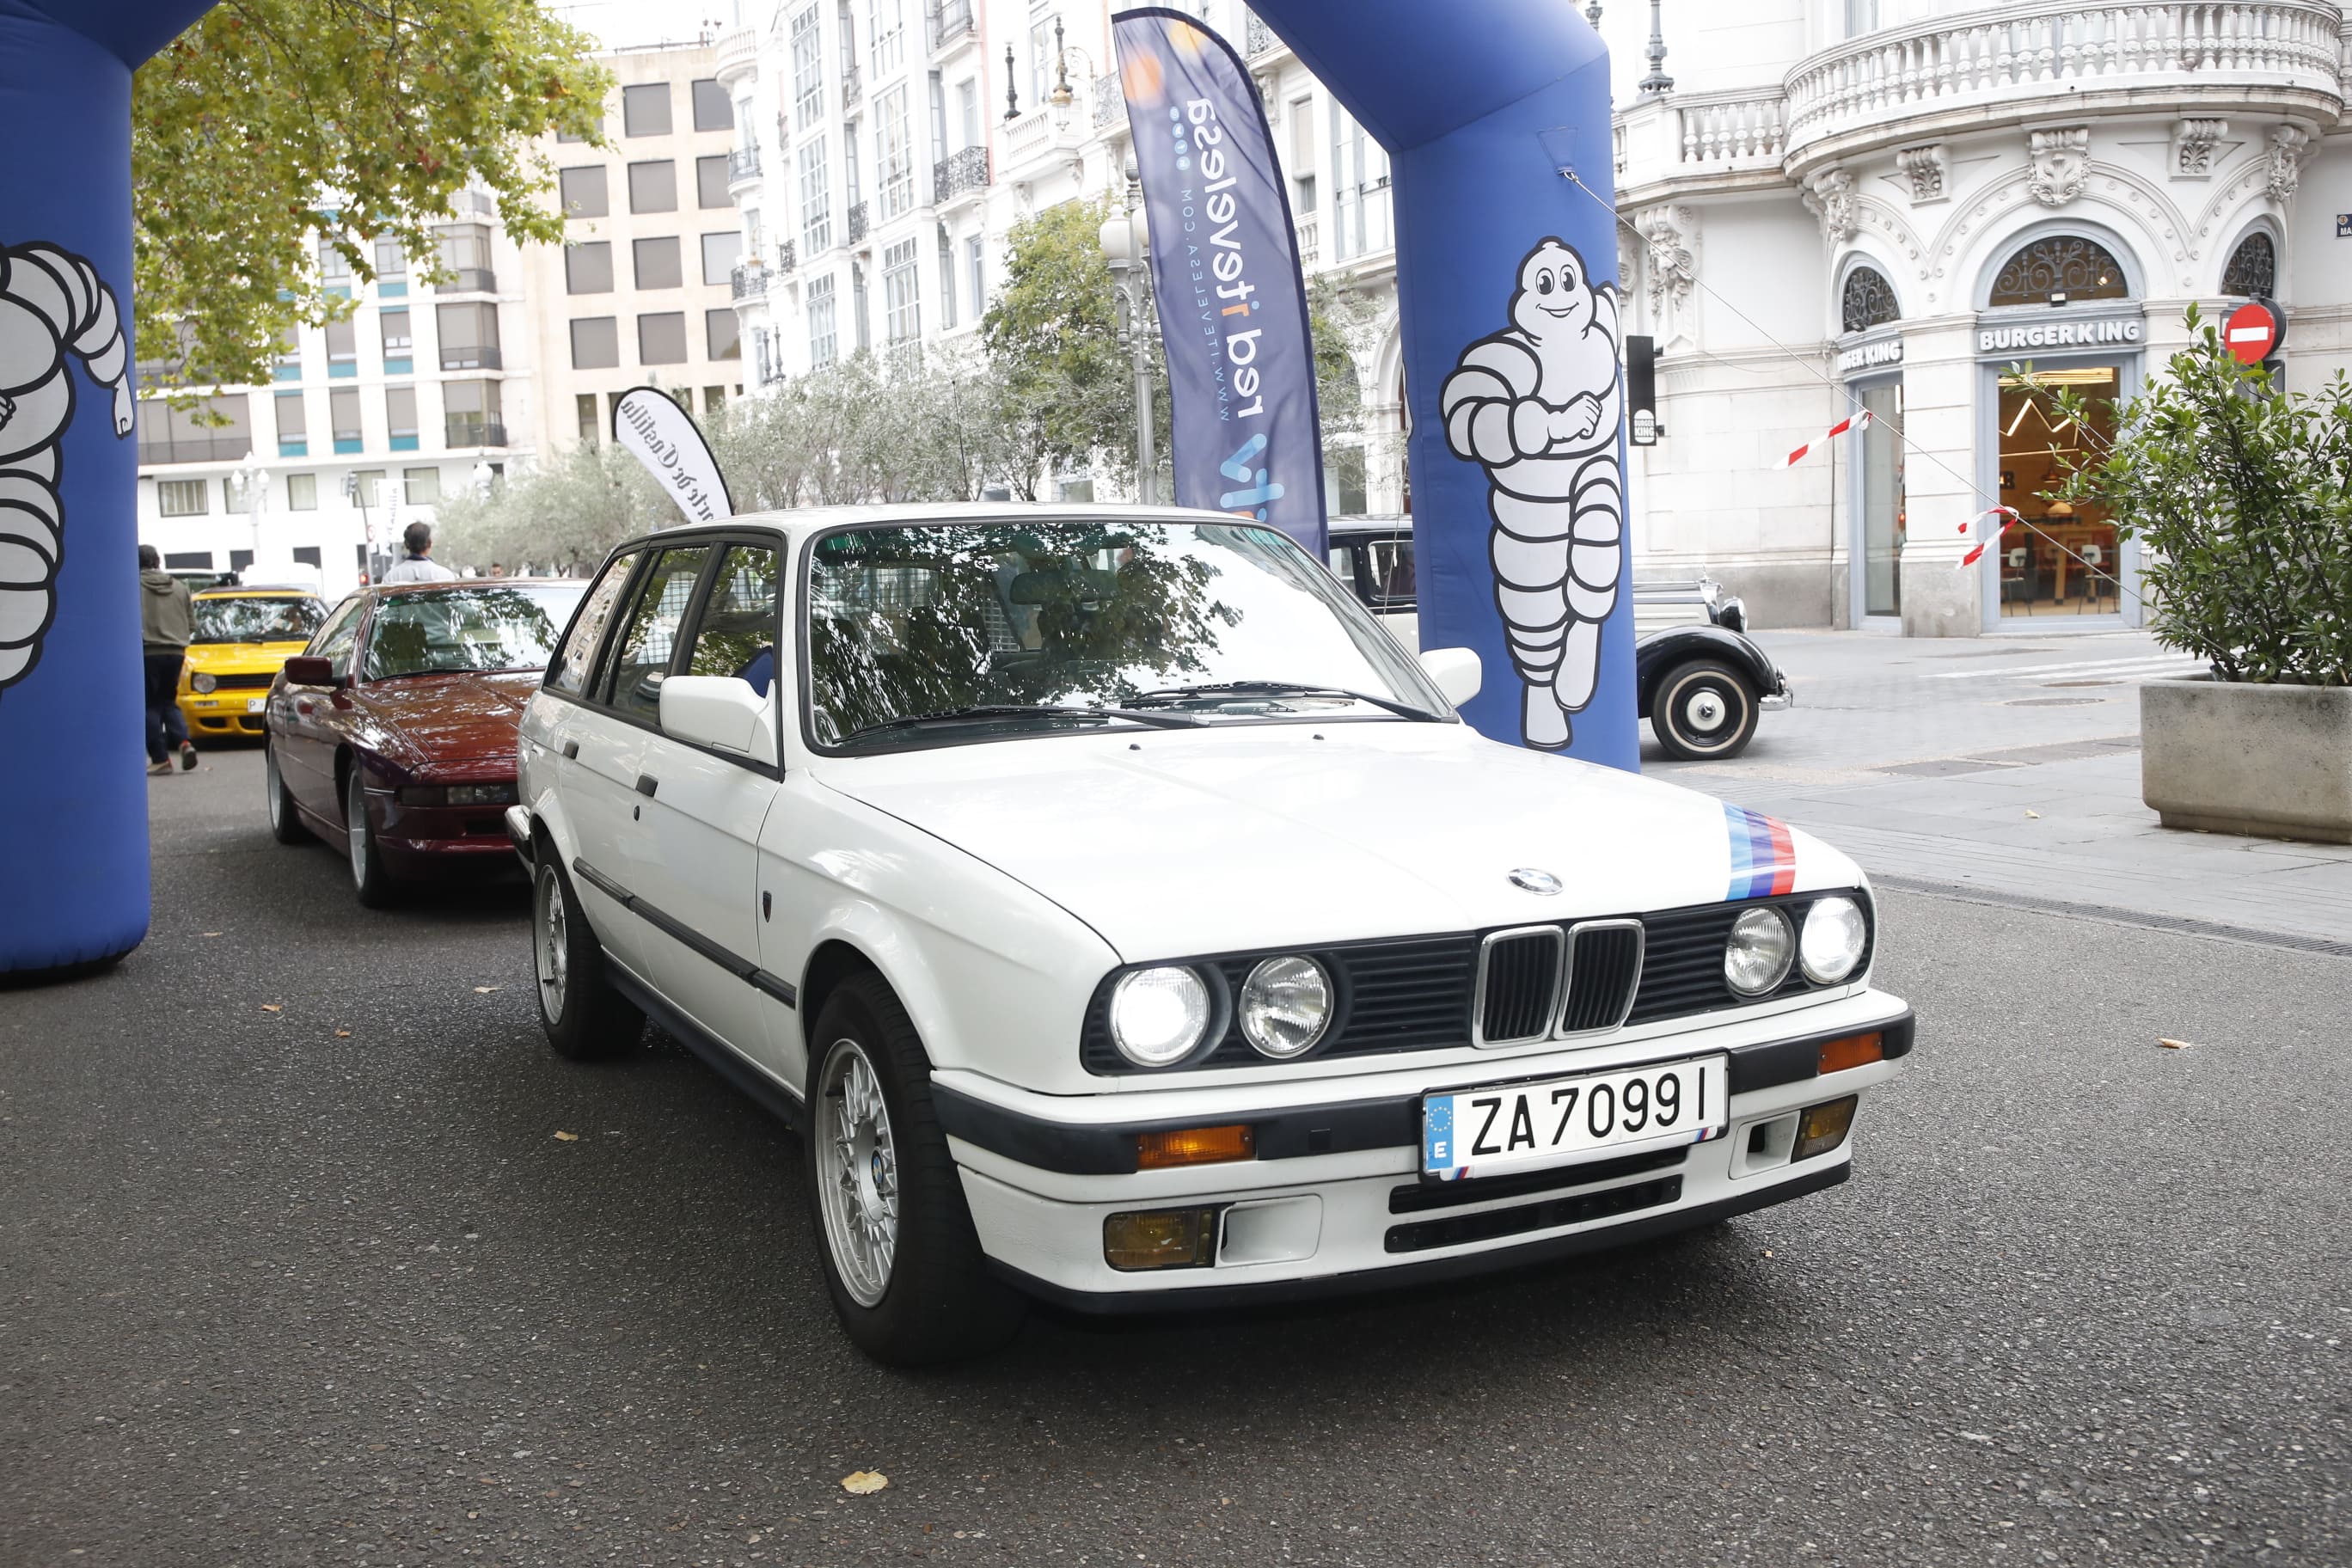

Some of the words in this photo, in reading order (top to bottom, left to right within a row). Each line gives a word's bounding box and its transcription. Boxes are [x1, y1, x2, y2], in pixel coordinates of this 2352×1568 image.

[1980, 326, 2076, 351] BURGER
[2077, 322, 2141, 344] KING
[1865, 341, 1901, 364] KING
[1634, 426, 1655, 437] KING
[1434, 1141, 1447, 1159] E
